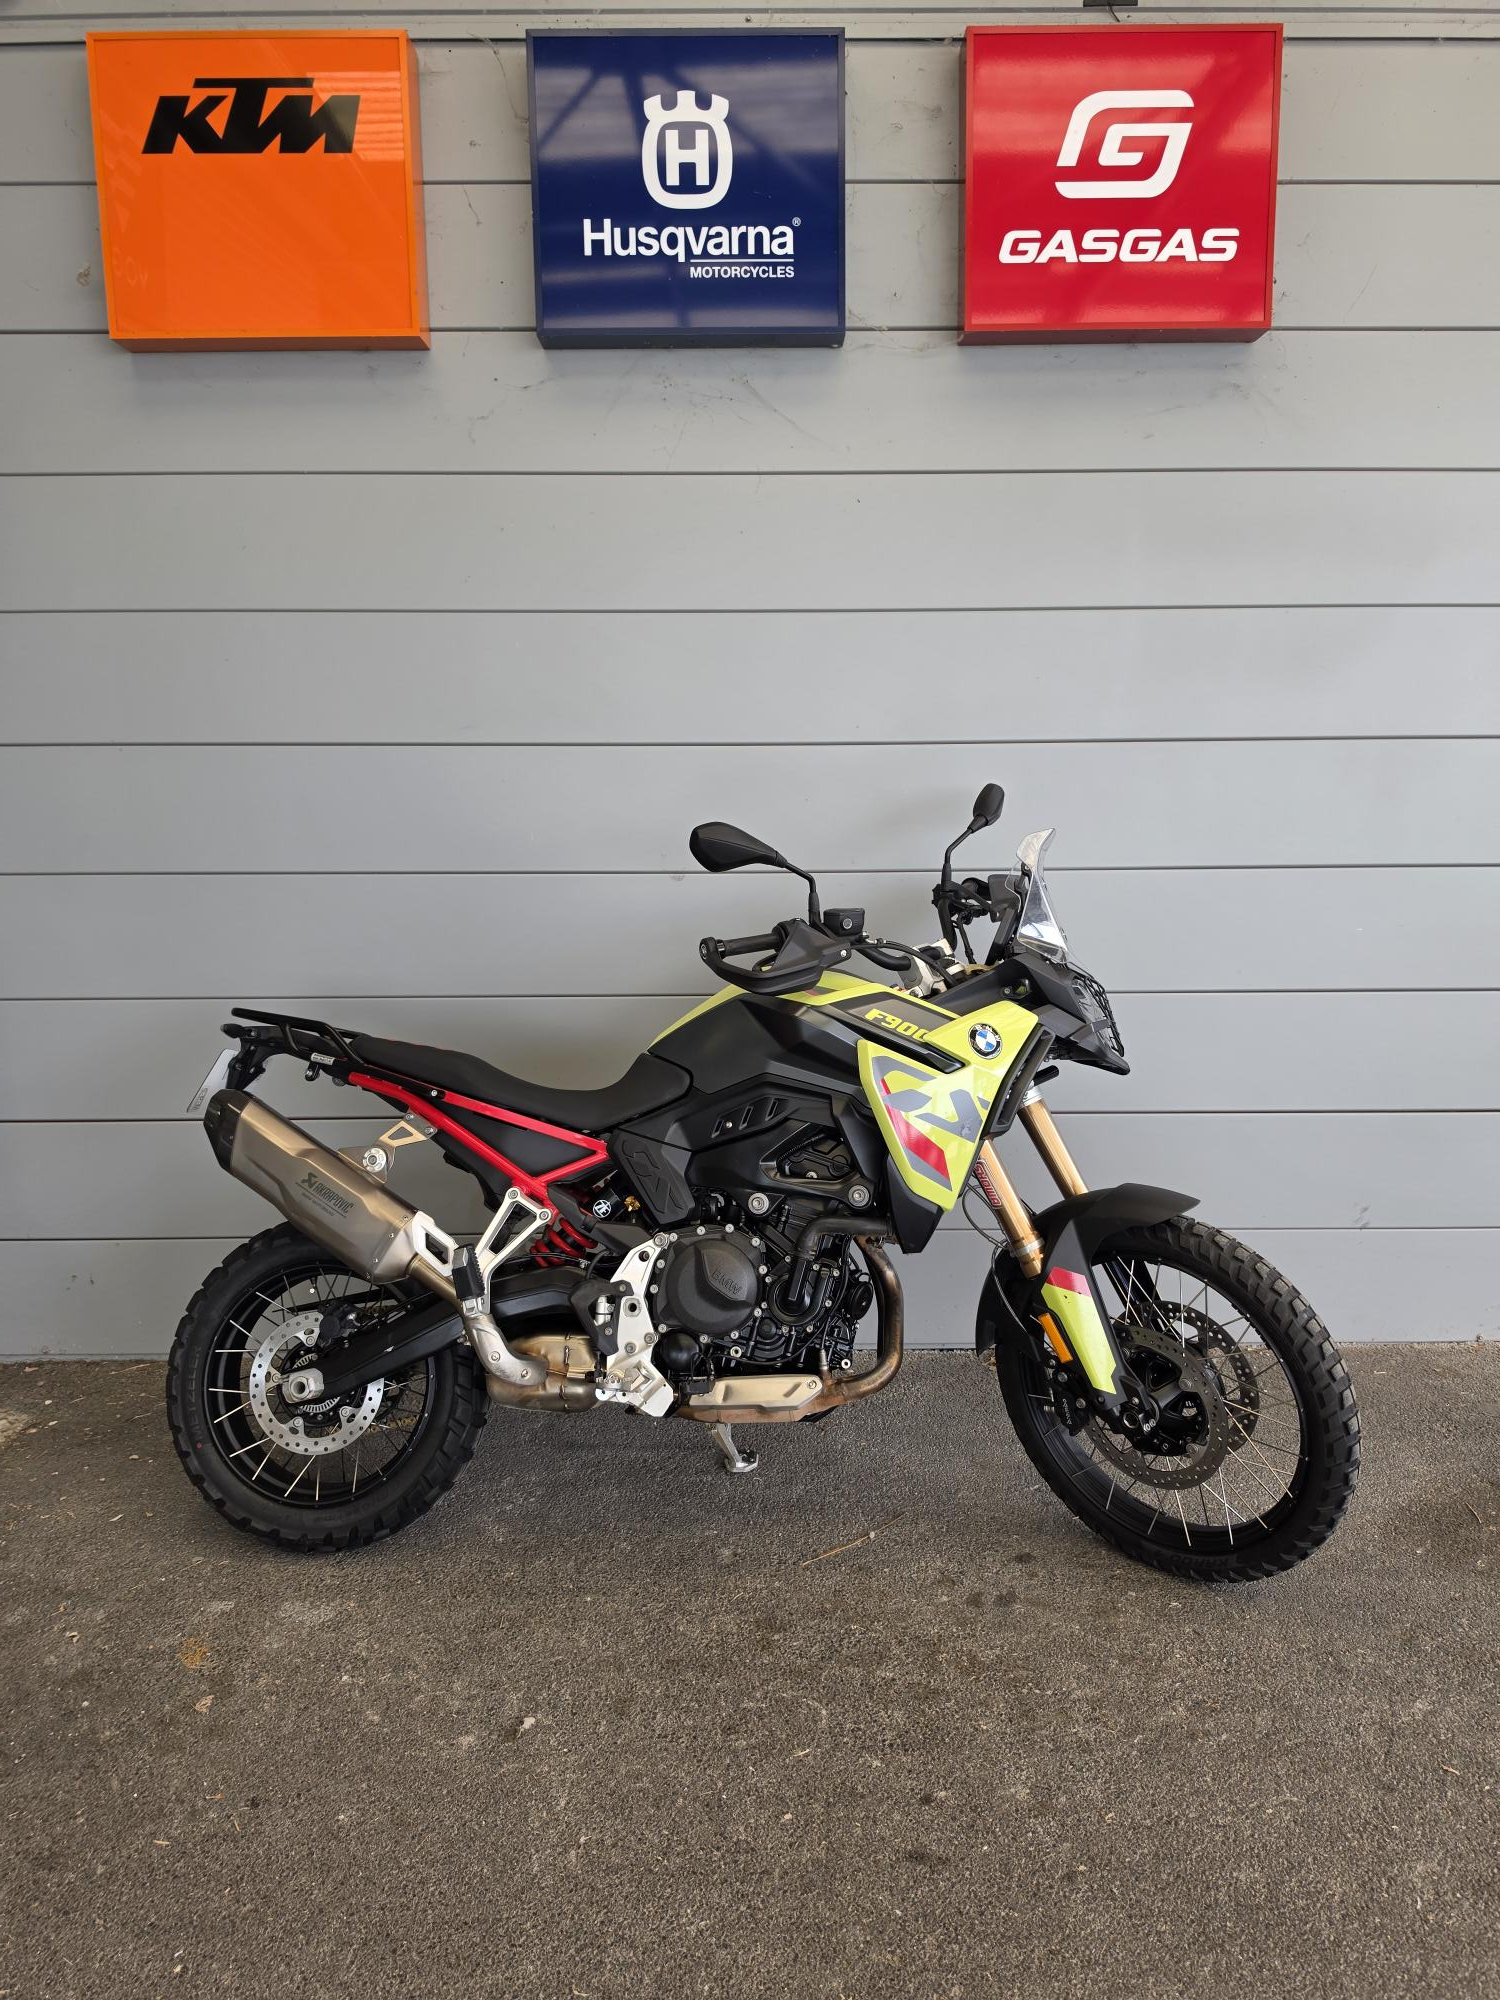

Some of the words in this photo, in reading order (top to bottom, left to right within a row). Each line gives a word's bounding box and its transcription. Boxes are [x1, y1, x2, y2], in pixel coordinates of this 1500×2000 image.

[141, 77, 361, 154] KTM
[583, 218, 795, 263] Husqvarna
[998, 227, 1240, 264] GASGAS
[689, 266, 795, 279] MOTORCYCLES
[973, 1162, 1002, 1207] SHOWA
